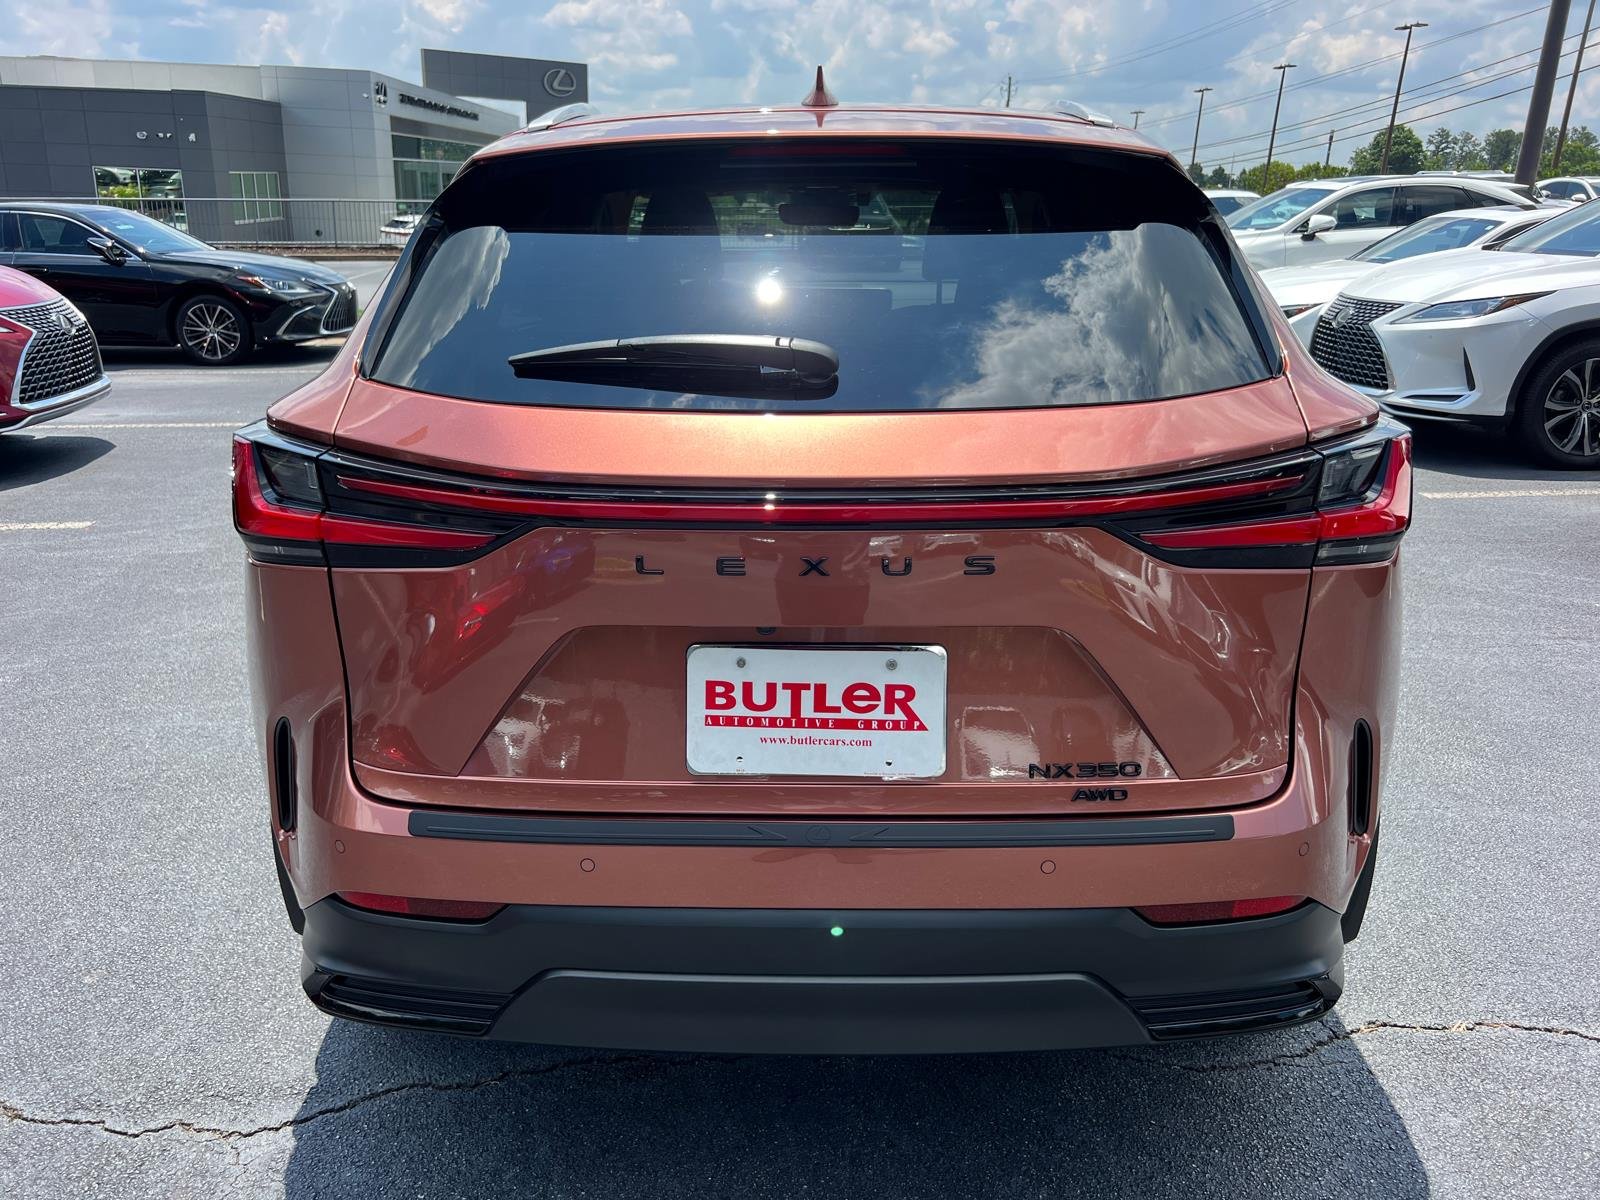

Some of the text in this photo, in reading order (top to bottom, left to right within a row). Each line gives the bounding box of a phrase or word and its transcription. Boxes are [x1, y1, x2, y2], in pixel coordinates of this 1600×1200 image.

[634, 555, 996, 577] LEXUS
[705, 717, 921, 731] AUTOMOTIVE GROUP
[759, 735, 873, 748] www.butlercars.com
[1028, 761, 1142, 779] NX350
[1070, 788, 1129, 802] AWD
